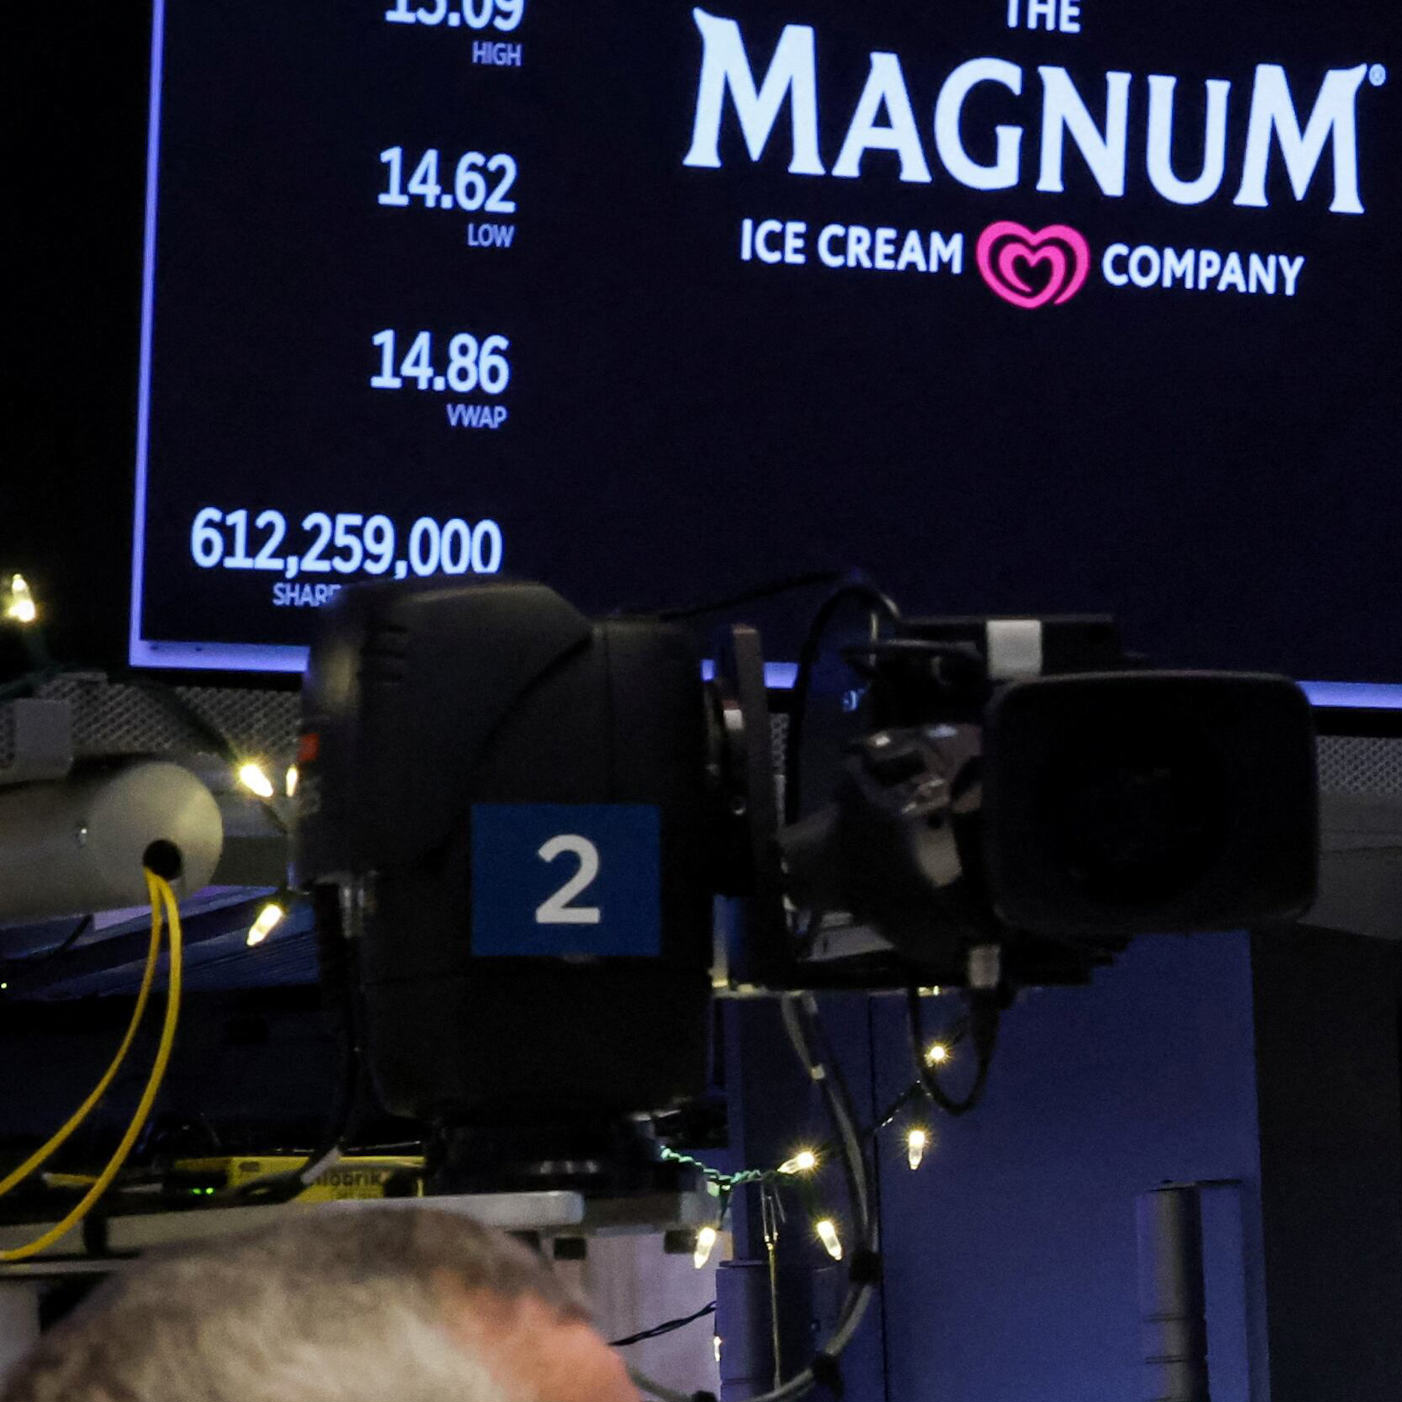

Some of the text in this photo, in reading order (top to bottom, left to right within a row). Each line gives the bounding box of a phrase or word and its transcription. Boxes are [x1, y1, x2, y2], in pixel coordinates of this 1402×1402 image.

[1007, 0, 1081, 33] THE
[473, 41, 522, 67] HIGH
[377, 146, 518, 213] 14.62
[467, 222, 514, 248] LOW
[741, 218, 1304, 296] ICE CREAM COMPANY
[370, 329, 510, 394] 14.86
[447, 403, 507, 429] VWAP
[190, 507, 503, 577] 612,259,000
[272, 582, 342, 607] SHAR
[534, 833, 601, 925] 2
